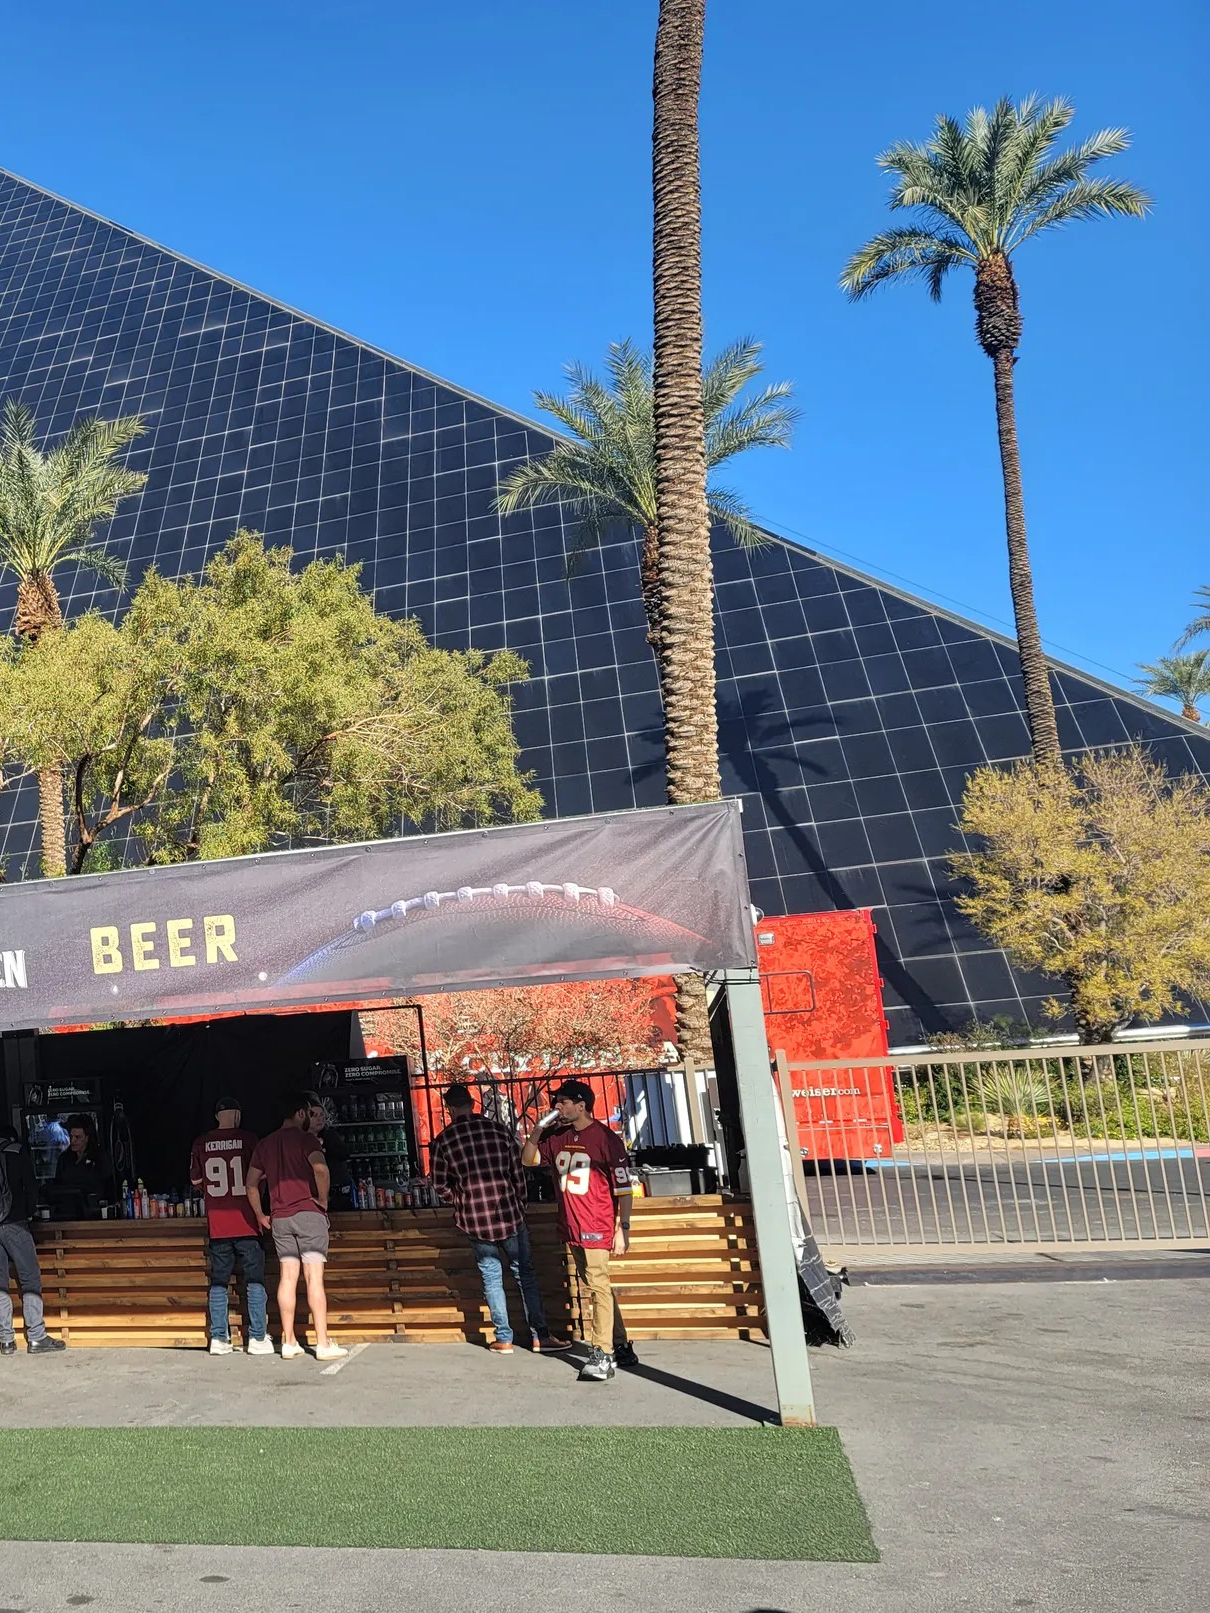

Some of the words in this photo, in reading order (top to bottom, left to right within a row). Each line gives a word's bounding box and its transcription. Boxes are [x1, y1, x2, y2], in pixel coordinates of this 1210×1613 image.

[90, 913, 239, 975] BEER
[204, 1155, 247, 1197] 91
[555, 1150, 591, 1196] 99
